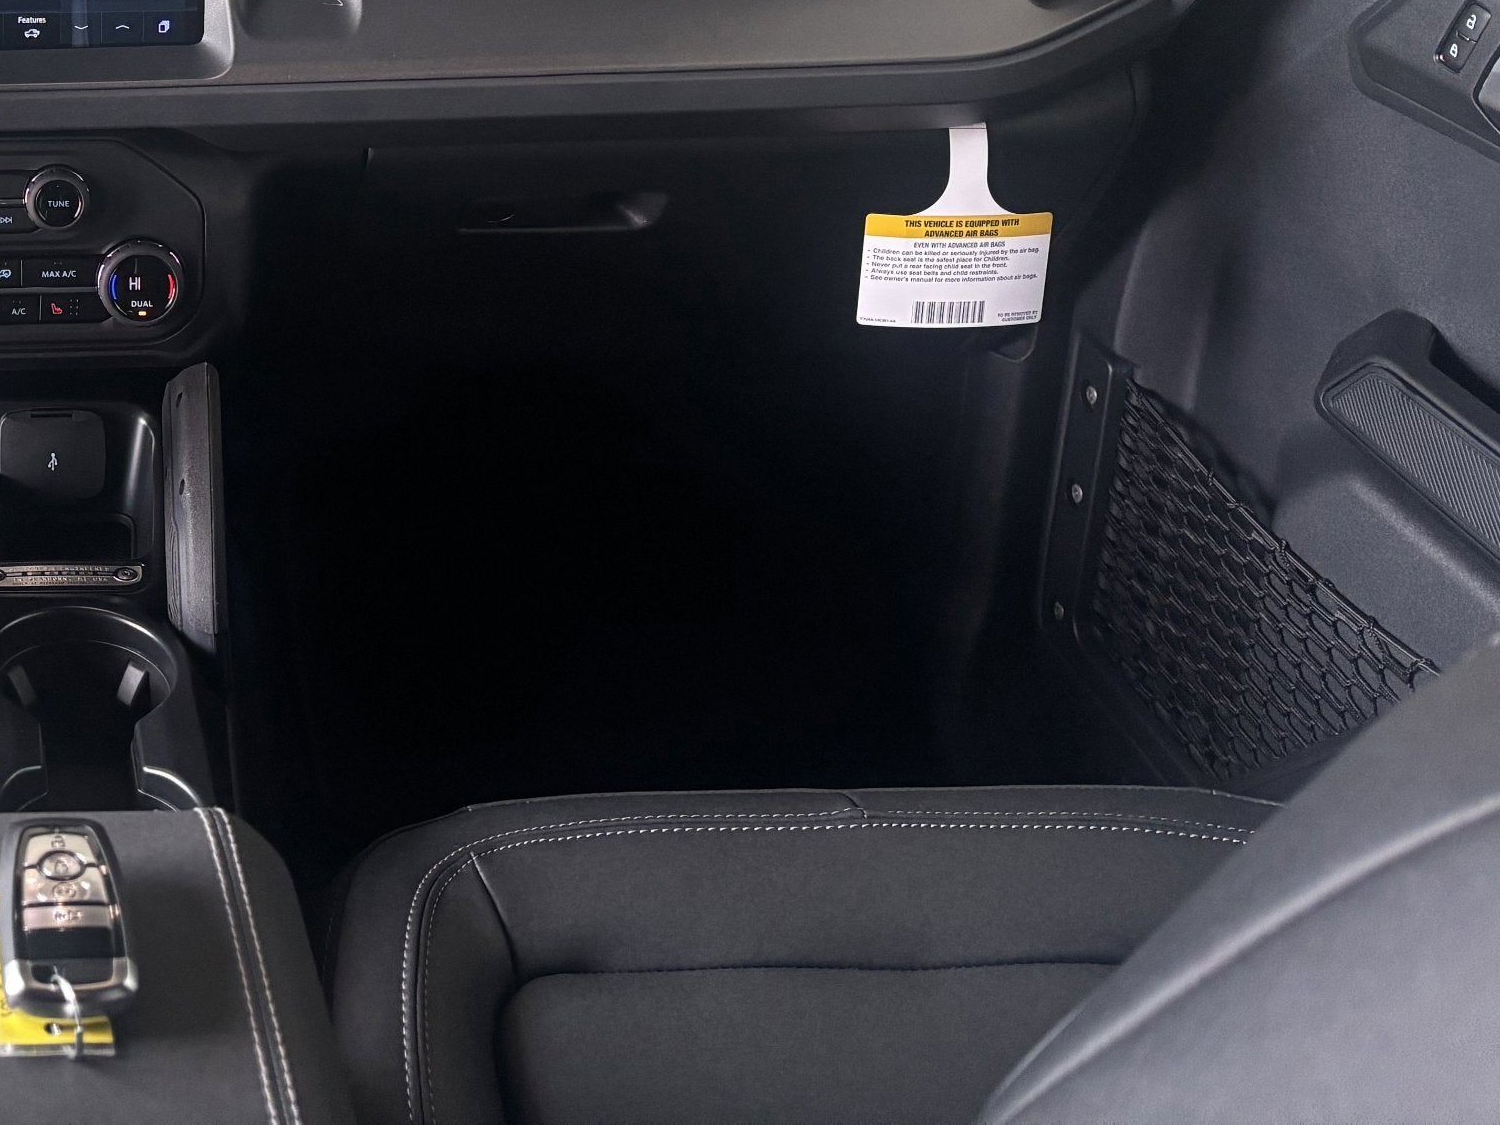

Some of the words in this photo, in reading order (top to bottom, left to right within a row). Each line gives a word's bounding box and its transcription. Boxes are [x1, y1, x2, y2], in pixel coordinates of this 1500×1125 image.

[18, 15, 47, 26] Features
[47, 199, 70, 208] TUNE
[924, 230, 963, 238] ADVANCED
[980, 229, 998, 237] BAGS
[873, 247, 900, 255] Children
[62, 270, 77, 279] A/C
[128, 277, 142, 291] HI
[130, 299, 153, 308] DUAL
